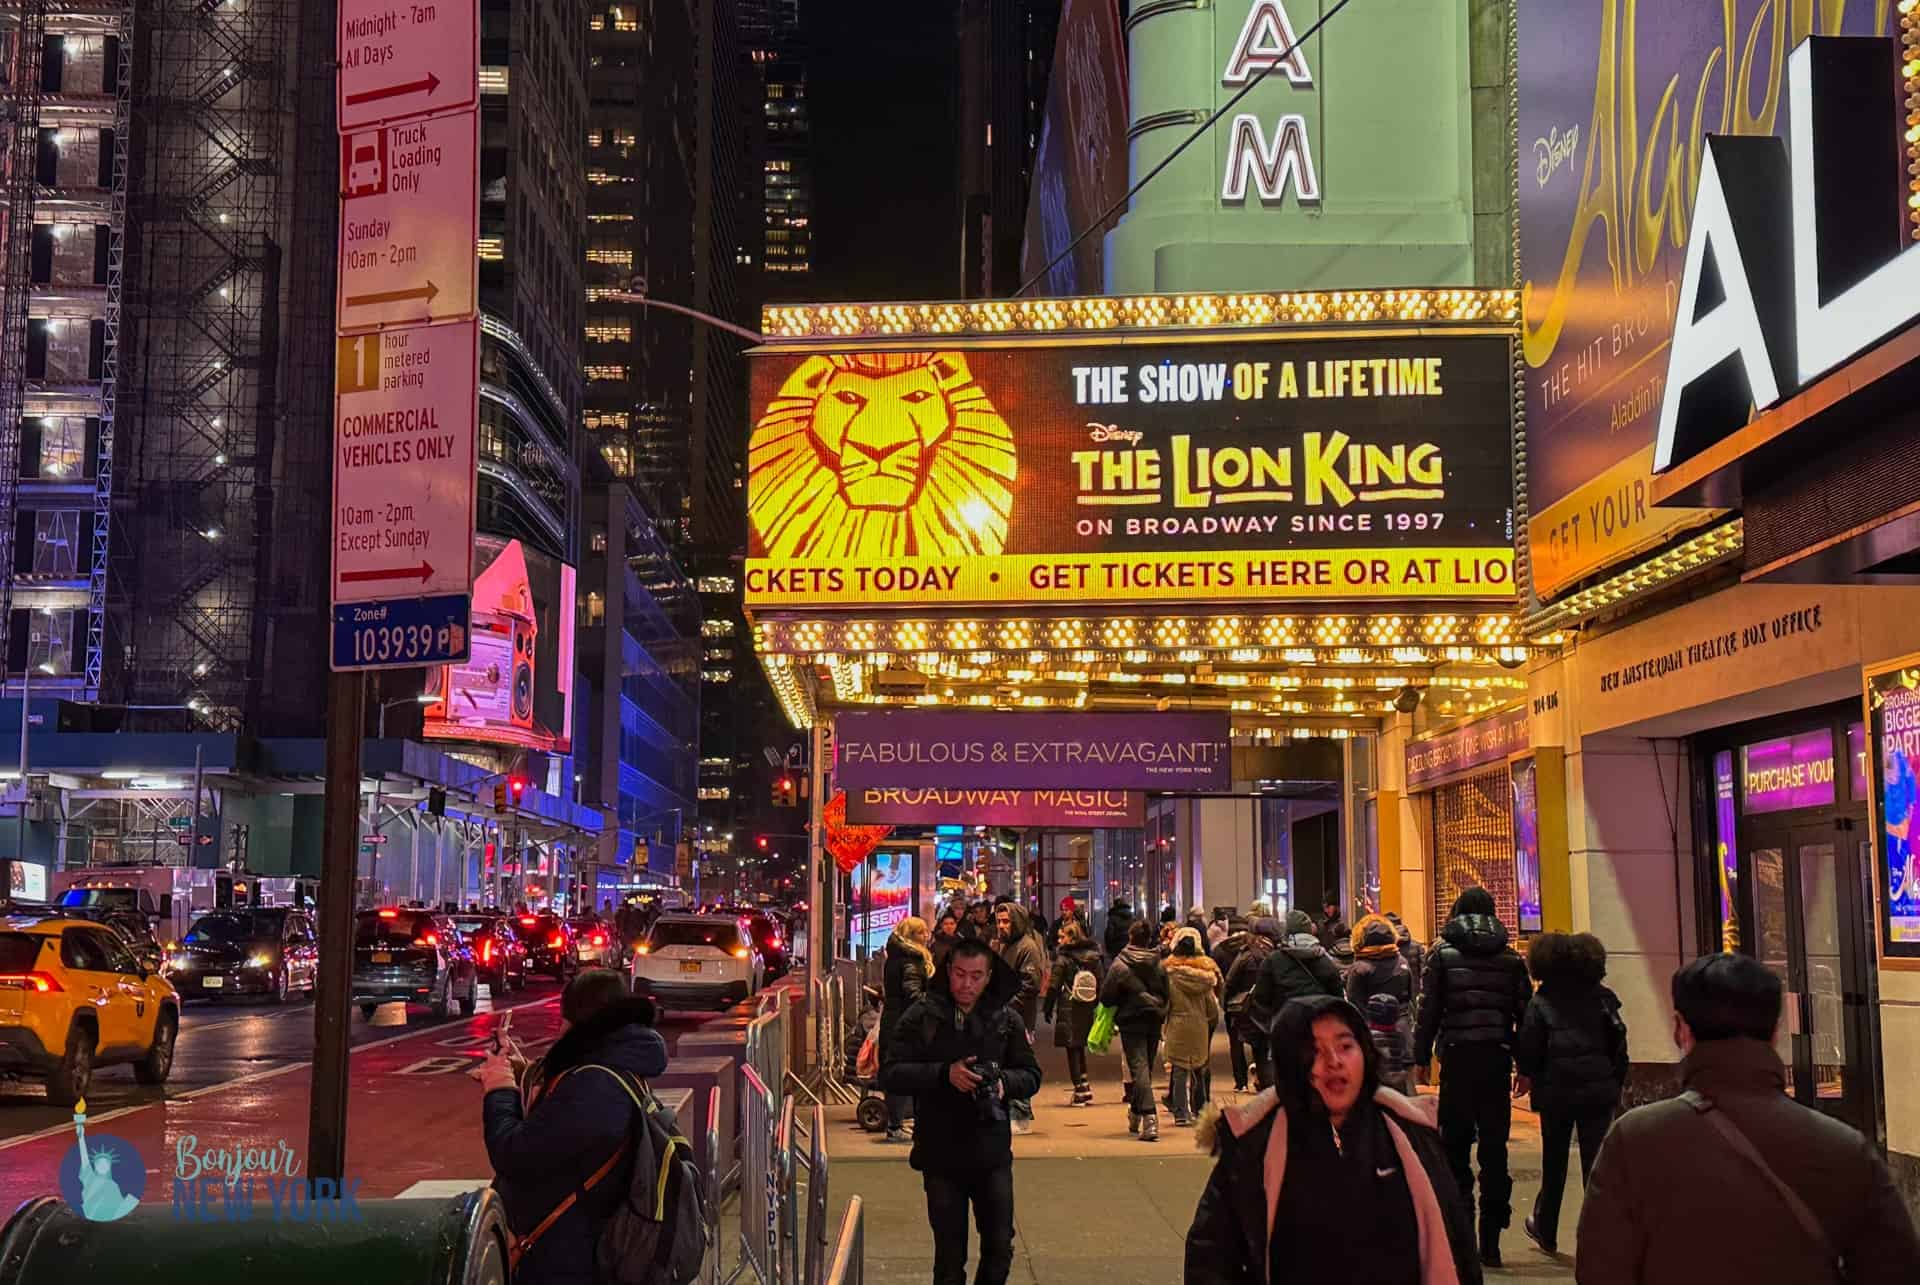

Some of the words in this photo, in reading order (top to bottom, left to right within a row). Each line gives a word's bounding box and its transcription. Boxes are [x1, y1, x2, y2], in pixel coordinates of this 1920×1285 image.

[346, 14, 397, 40] Midnight
[411, 5, 435, 24] 7am
[345, 49, 360, 69] All
[364, 44, 394, 66] Days
[392, 122, 427, 148] Truck
[392, 146, 441, 170] Loading
[392, 172, 420, 192] Only
[348, 219, 390, 242] Sunday
[346, 250, 377, 270] 10am
[390, 244, 416, 266] 2pm
[384, 332, 409, 350] hour
[353, 335, 366, 387] 1
[384, 349, 430, 370] metered
[384, 369, 424, 392] parking
[1072, 366, 1129, 404] THE
[1138, 363, 1226, 403] SHOW
[1233, 361, 1271, 400] OF
[1278, 361, 1299, 399] A
[1307, 358, 1443, 398] LIFETIME
[1542, 364, 1571, 412] THE
[1577, 336, 1603, 386] HIT
[343, 407, 438, 438] COMMERCIAL
[343, 440, 410, 469] VEHICLES
[416, 435, 455, 461] ONLY
[1071, 448, 1161, 491] THE
[1171, 434, 1293, 508] LION
[1303, 429, 1444, 508] KING
[341, 506, 374, 526] 10am
[386, 503, 413, 525] 2pm
[1076, 519, 1113, 536] ON
[1126, 515, 1279, 535] BROADWAY
[1291, 514, 1372, 532] SINCE
[1384, 512, 1445, 530] 1997
[1550, 515, 1580, 565] GET
[1590, 480, 1646, 545] YOUR
[341, 531, 382, 552] Except
[384, 527, 430, 550] Sunday
[855, 565, 961, 593] TODAY
[1029, 563, 1091, 590] GET
[1101, 561, 1235, 589] TICKETS
[1246, 560, 1332, 587] HERE
[1343, 559, 1390, 586] OR
[1402, 559, 1442, 585] AT
[354, 606, 386, 622] Zone#
[353, 625, 433, 661] 103939
[1686, 631, 1737, 665] THEATRE
[1742, 622, 1768, 649] BOX
[1772, 604, 1822, 640] OFFICE
[991, 742, 1009, 763] &
[1749, 764, 1806, 794] PURCHASE
[864, 790, 1023, 806] BROADWAY
[1033, 790, 1129, 808] MAGIC!
[767, 1171, 776, 1246] NYPD
